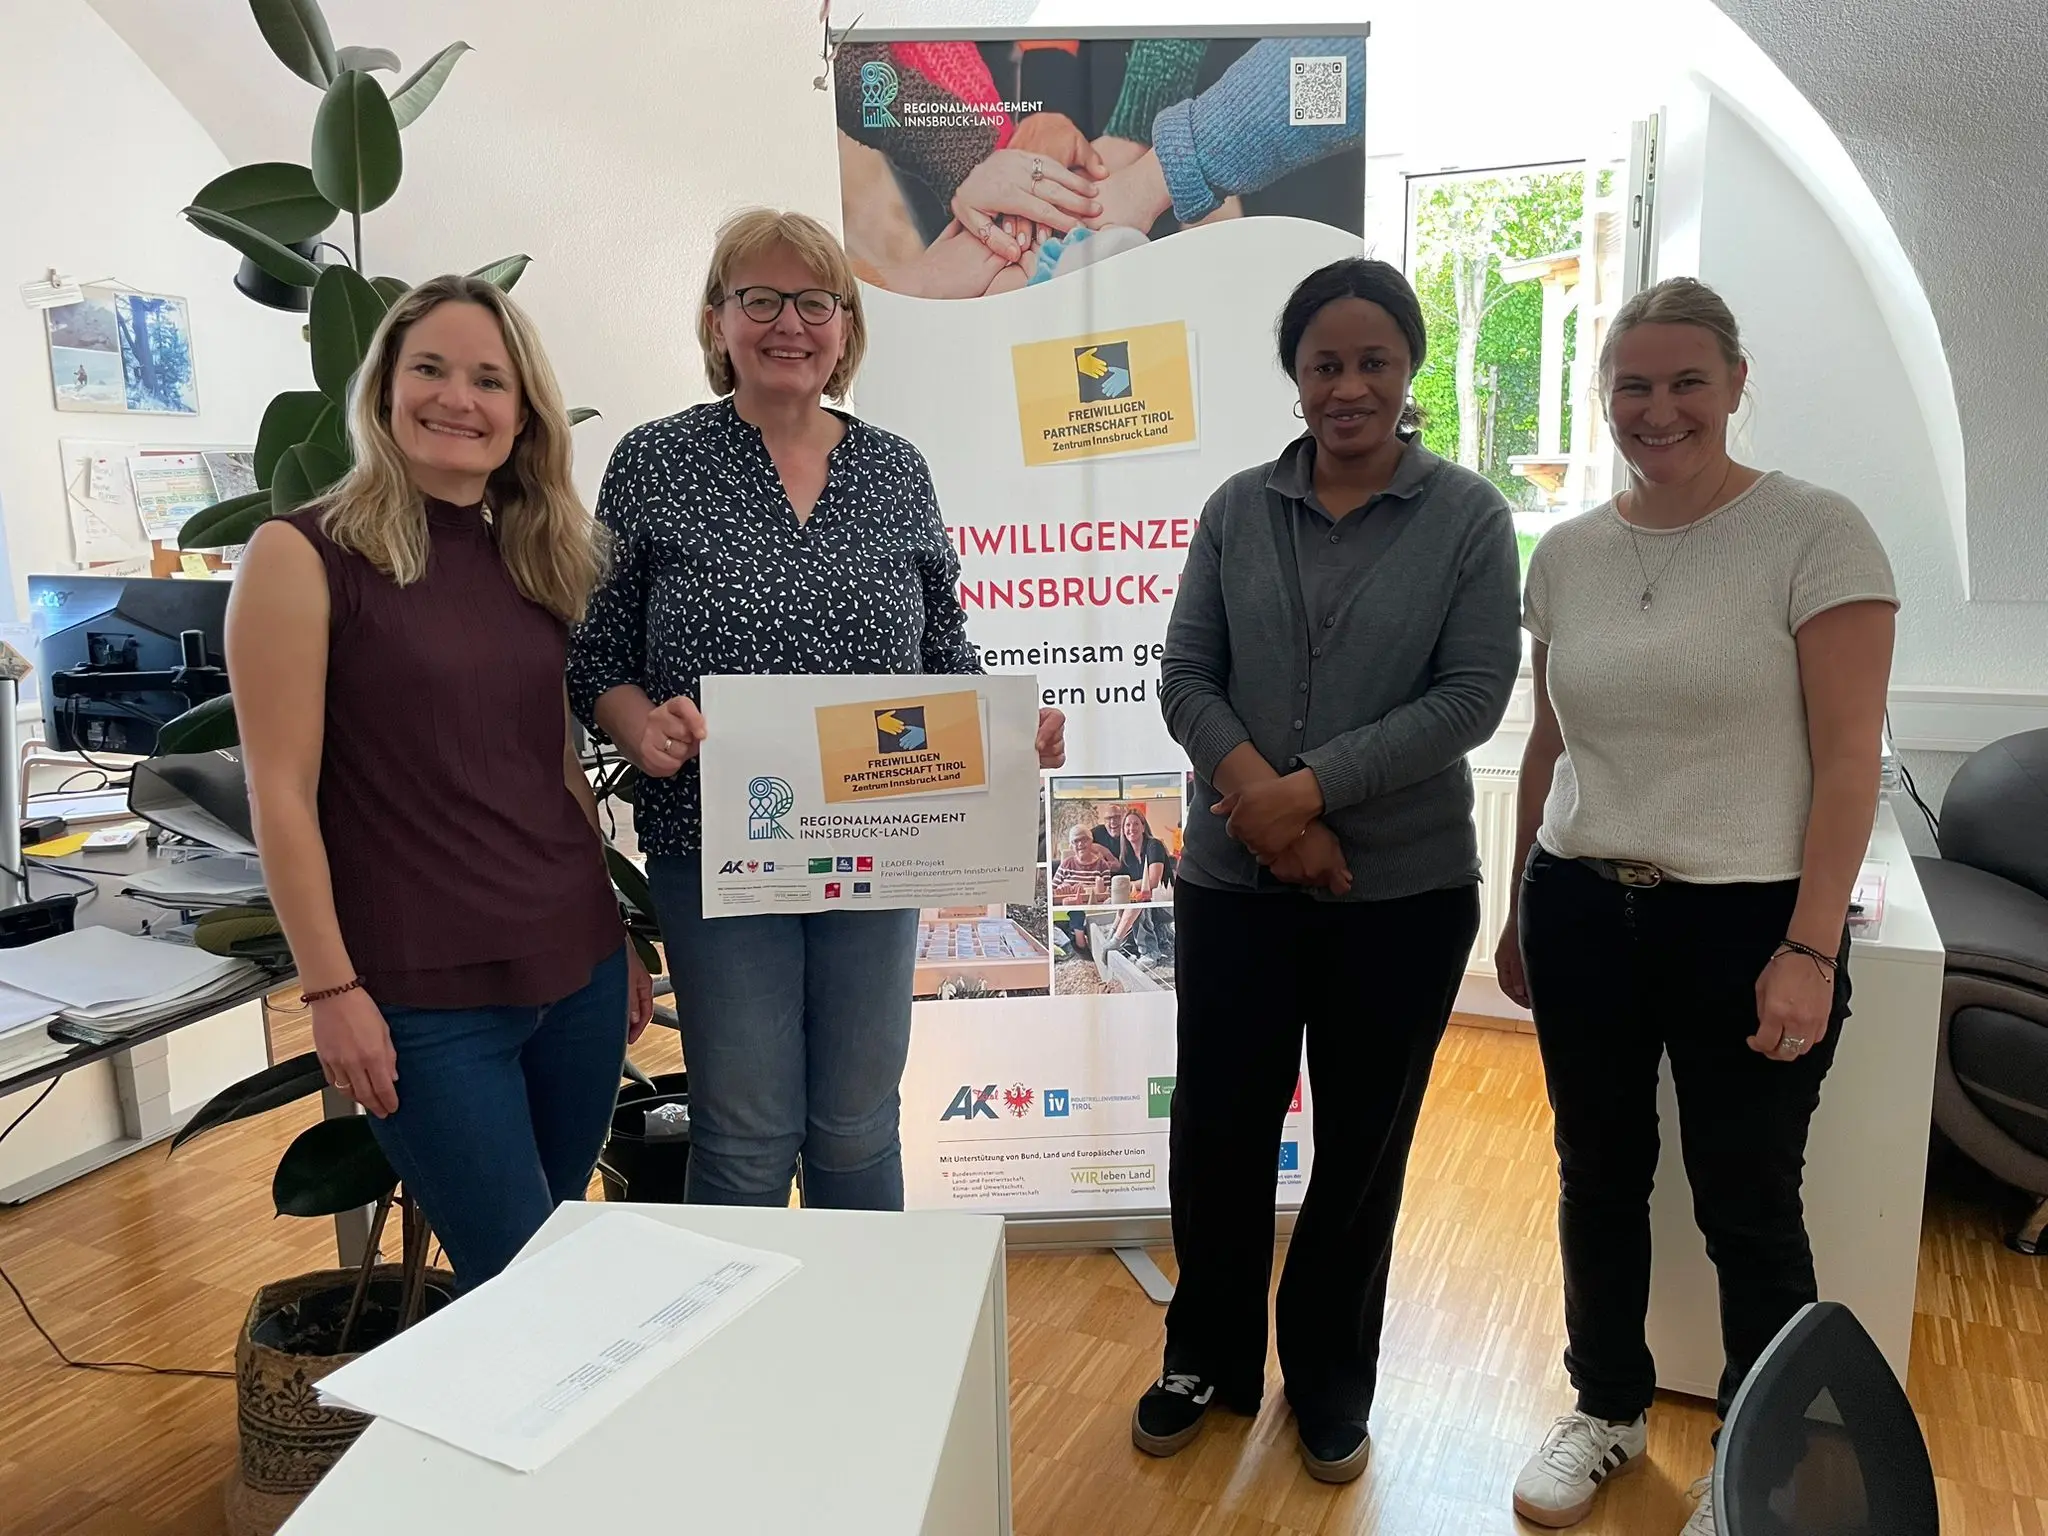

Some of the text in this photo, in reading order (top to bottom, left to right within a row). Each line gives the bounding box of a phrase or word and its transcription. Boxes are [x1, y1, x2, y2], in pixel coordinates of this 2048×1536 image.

[904, 101, 1043, 113] REGIONALMANAGEMENT
[904, 115, 1004, 127] INNSBRUCK-LAND
[1068, 400, 1146, 421] FREIWILLIGEN
[1043, 411, 1174, 439] PARTNERSCHAFT TIROL
[1053, 425, 1168, 451] Zentrum Innsbruck Land
[945, 518, 1199, 555] IWILLIGENZE
[960, 574, 1183, 610] NNSBRUCK-
[1134, 642, 1164, 667] ge
[1042, 687, 1085, 705] ern
[1096, 679, 1145, 704] und
[868, 753, 940, 769] FREIWILLIGEN
[844, 761, 966, 782] PARTNERSCHAFT TIROL
[852, 772, 960, 792] Zentrum Innsbruck Land
[800, 813, 966, 826] REGIONALMANAGEMENT
[800, 827, 919, 839] INNSBRUCK-LAND
[718, 860, 744, 874] AK
[880, 860, 945, 868] LEADER-Projekt
[880, 865, 1024, 878] Freiwilligenzentrum Innsbruck-Land
[940, 1084, 999, 1121] AK
[1049, 1093, 1065, 1111] iv
[954, 1154, 1004, 1163] Unterstützung
[1021, 1152, 1041, 1160] Bund,
[1043, 1151, 1060, 1159] Land
[1062, 1150, 1075, 1158] und
[1077, 1149, 1122, 1158] Europäischer
[1124, 1148, 1145, 1156] Union
[1070, 1169, 1151, 1185] WIR leben Land
